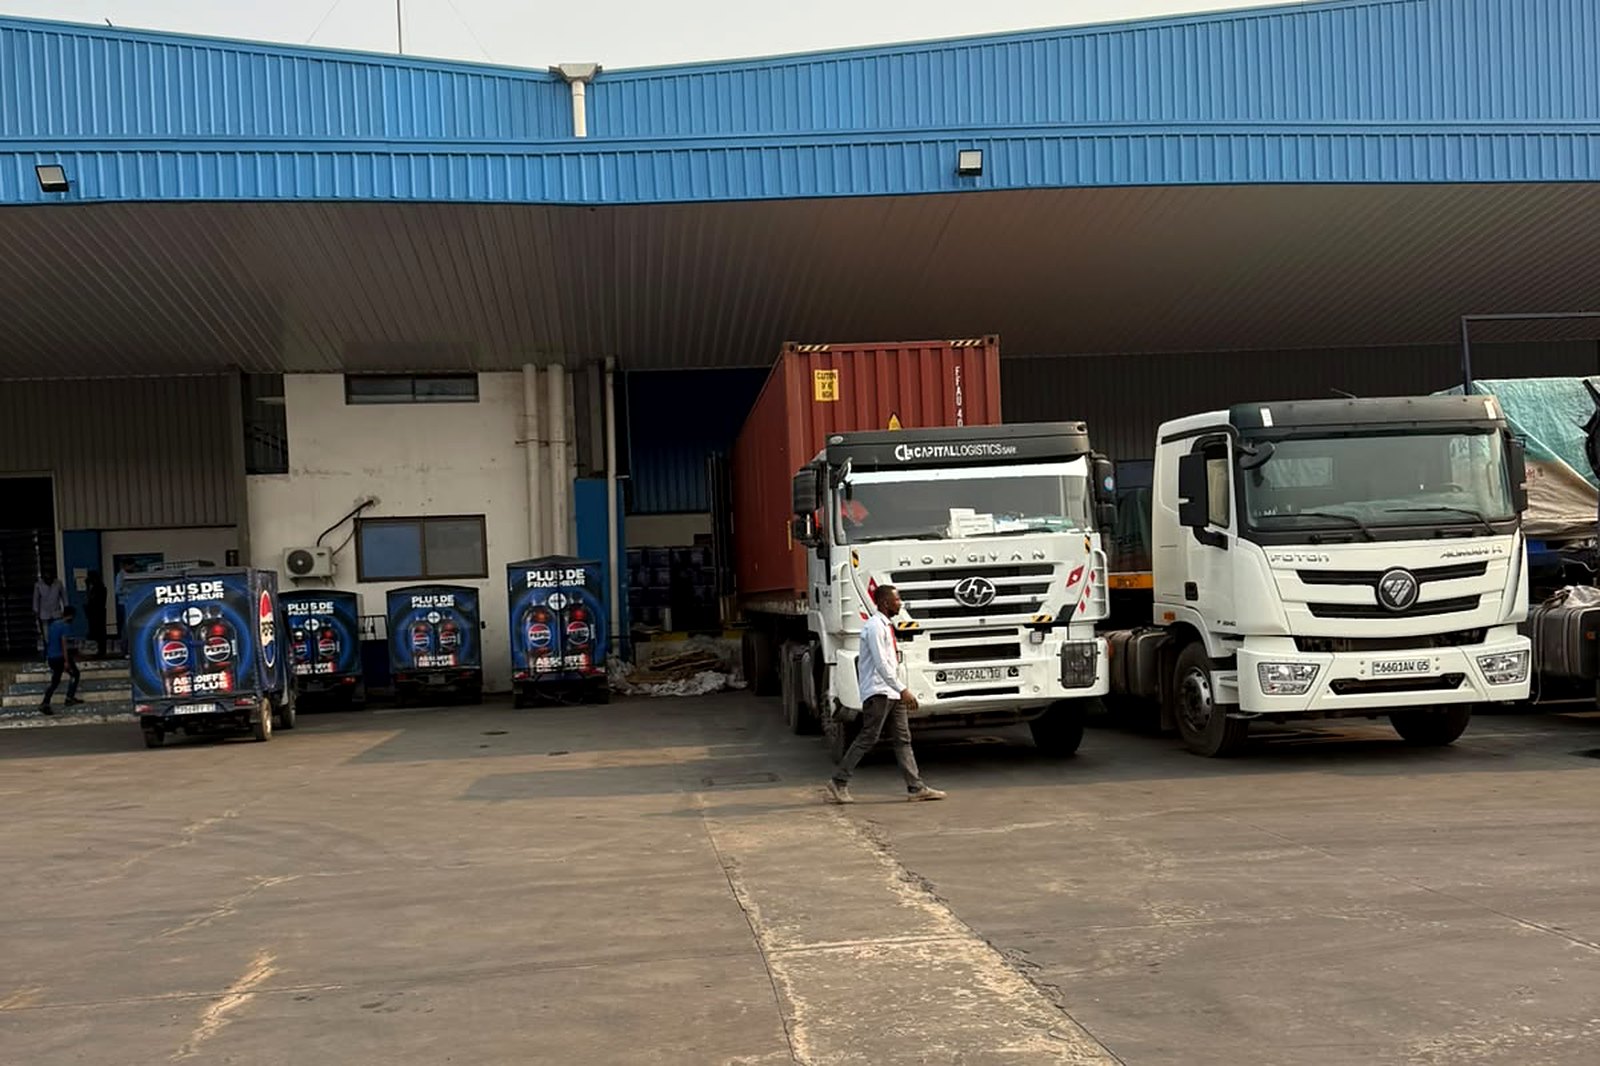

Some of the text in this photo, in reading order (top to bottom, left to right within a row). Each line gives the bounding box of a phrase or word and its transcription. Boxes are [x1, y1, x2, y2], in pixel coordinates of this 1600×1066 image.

[527, 568, 585, 581] PLUS DE
[155, 581, 224, 598] PLUS DE
[411, 594, 454, 604] PLUS DE
[287, 601, 334, 612] PLUS DE
[173, 681, 229, 694] DE PLUS
